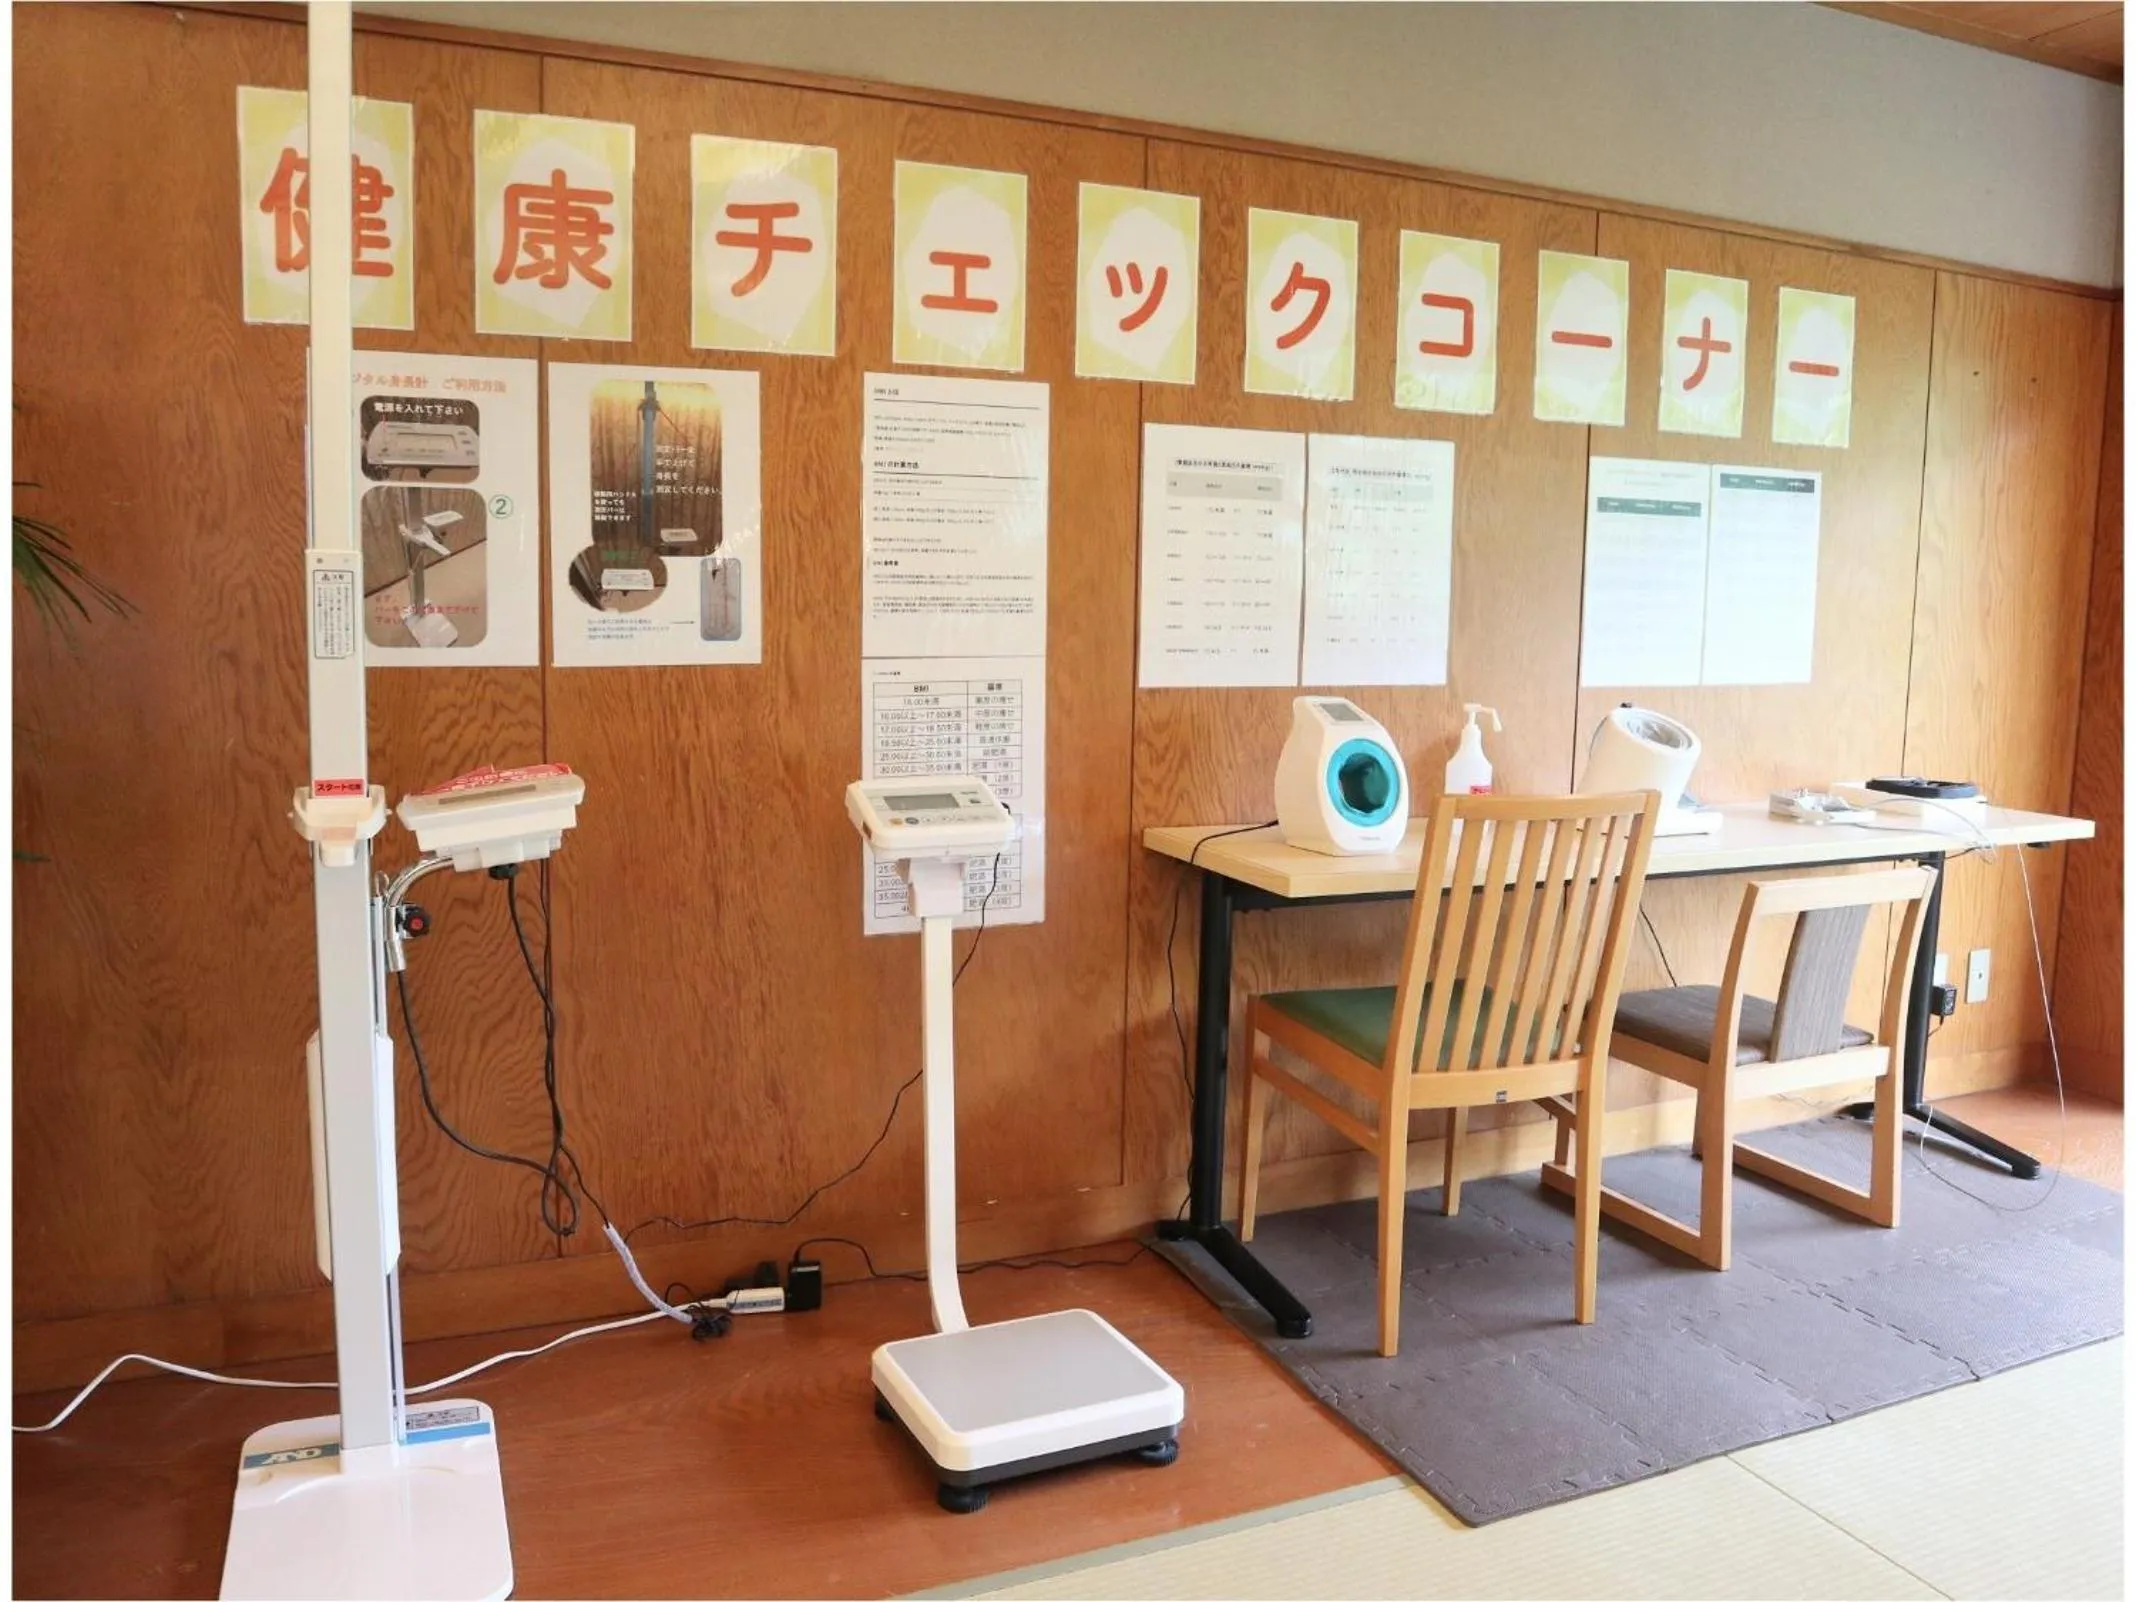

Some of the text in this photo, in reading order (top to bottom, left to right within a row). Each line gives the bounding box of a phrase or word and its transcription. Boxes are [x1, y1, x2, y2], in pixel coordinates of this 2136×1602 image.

[260, 147, 1839, 391] 健康チェックコーナー
[373, 402, 464, 416] 電源を入れて下さい
